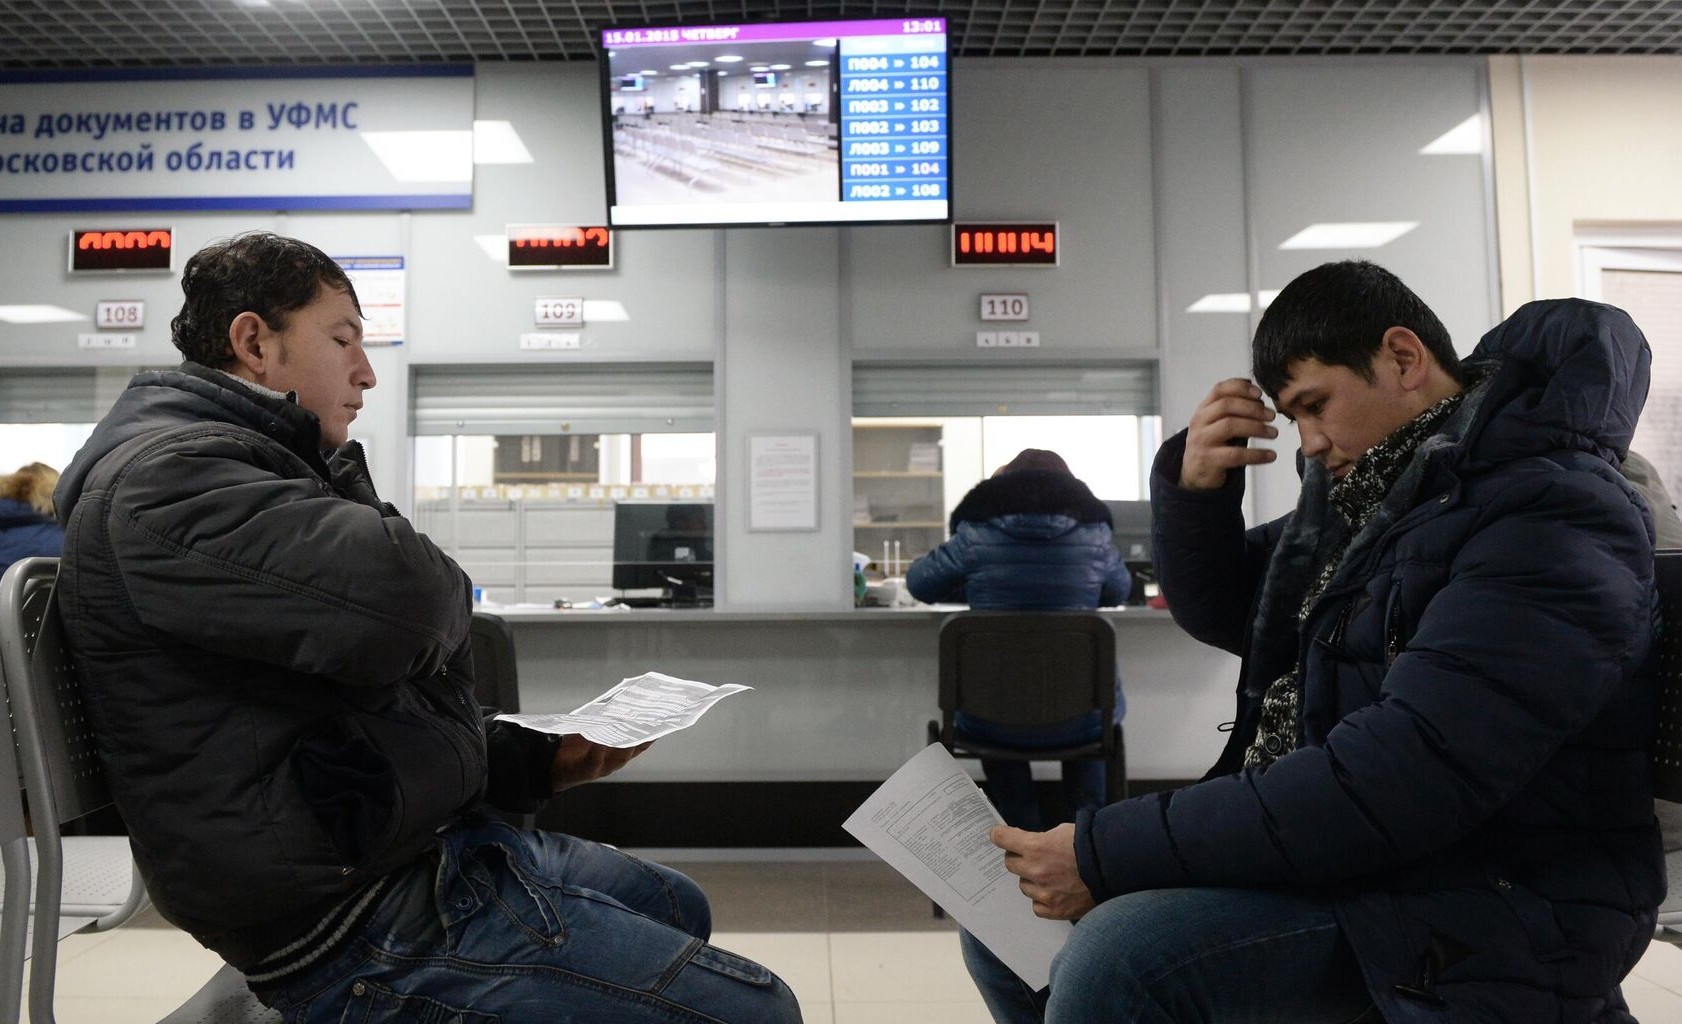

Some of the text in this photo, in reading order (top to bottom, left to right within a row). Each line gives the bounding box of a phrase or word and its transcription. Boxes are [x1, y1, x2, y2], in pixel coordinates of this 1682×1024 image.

[903, 20, 941, 33] 13:01
[605, 27, 740, 44] 15.01.2015 ЧЕТВЕРГ
[910, 56, 939, 69] 104
[911, 77, 939, 90] 110
[911, 98, 939, 112] 102
[34, 110, 226, 139] документов
[239, 110, 255, 130] в
[266, 101, 359, 131] УФМС
[911, 120, 939, 133] 103
[911, 141, 940, 154] 109
[0, 143, 294, 173] сковской области
[912, 162, 940, 175] 104
[912, 184, 940, 197] 108
[542, 303, 576, 319] 109
[987, 299, 1023, 315] 110
[104, 306, 138, 322] 108
